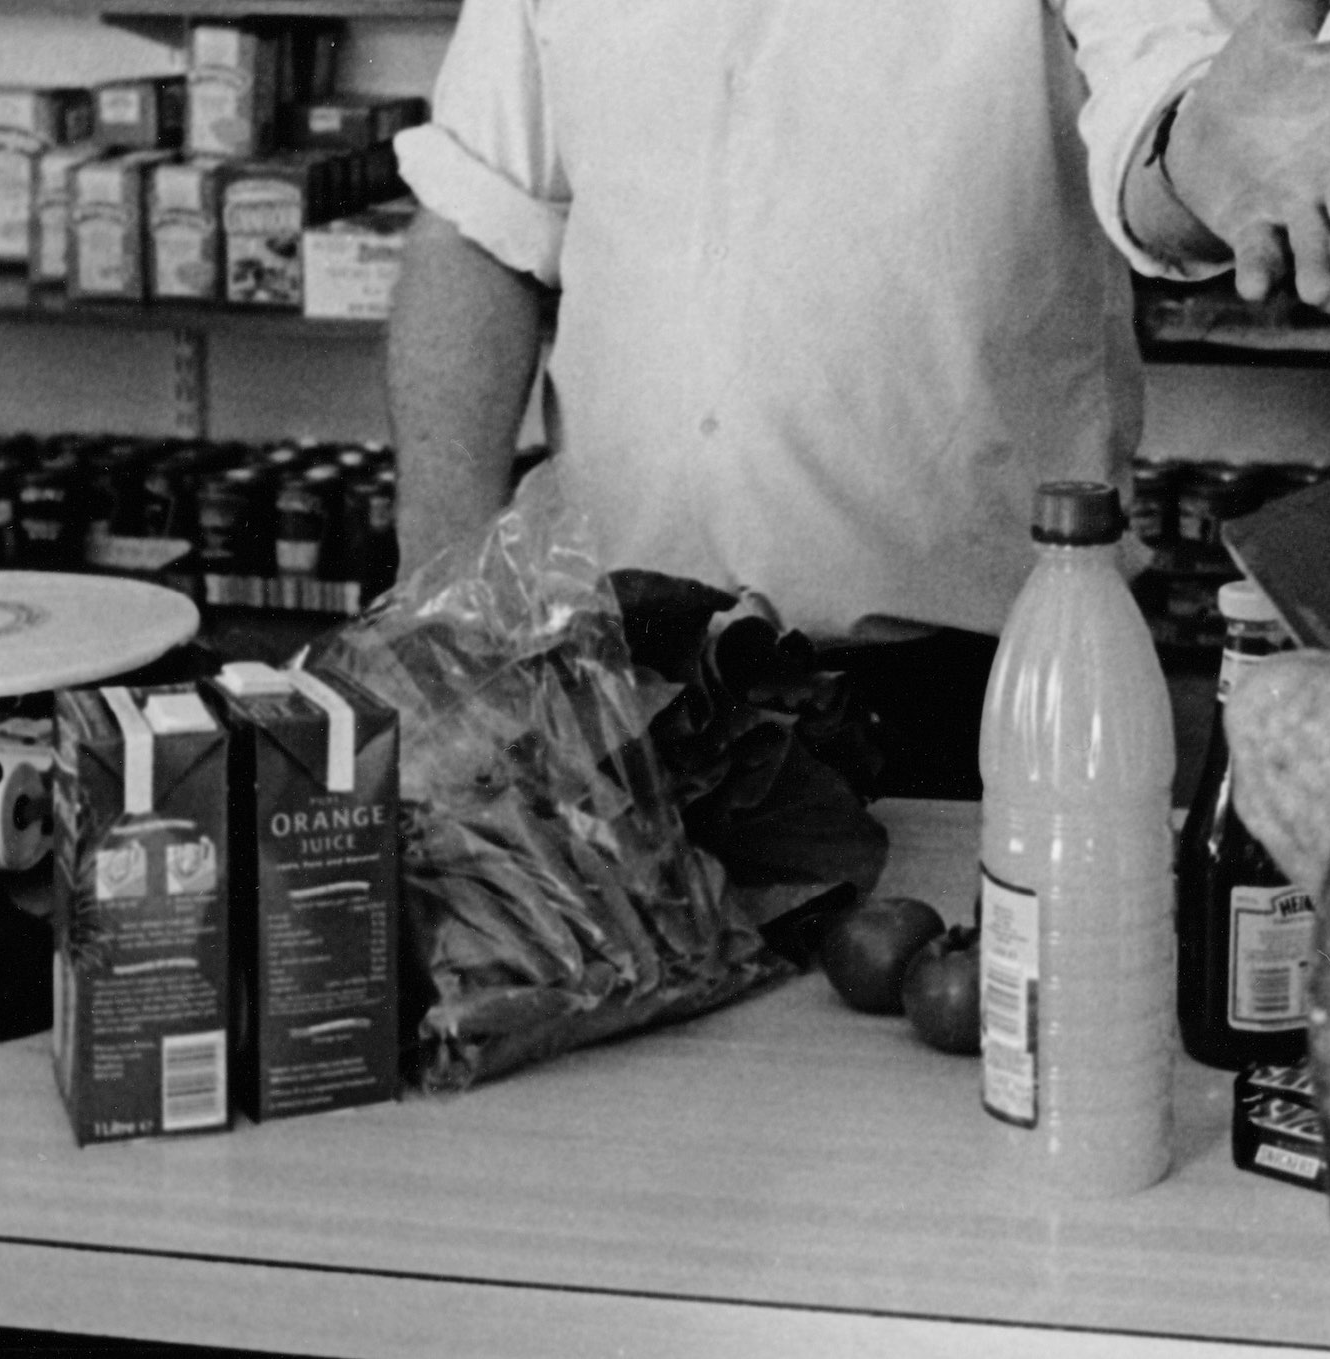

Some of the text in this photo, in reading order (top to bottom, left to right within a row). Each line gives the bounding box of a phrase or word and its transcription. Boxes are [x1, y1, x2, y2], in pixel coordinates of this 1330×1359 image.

[271, 804, 385, 837] ORANGE
[301, 833, 355, 854] JUICE
[1280, 895, 1315, 917] HEIN
